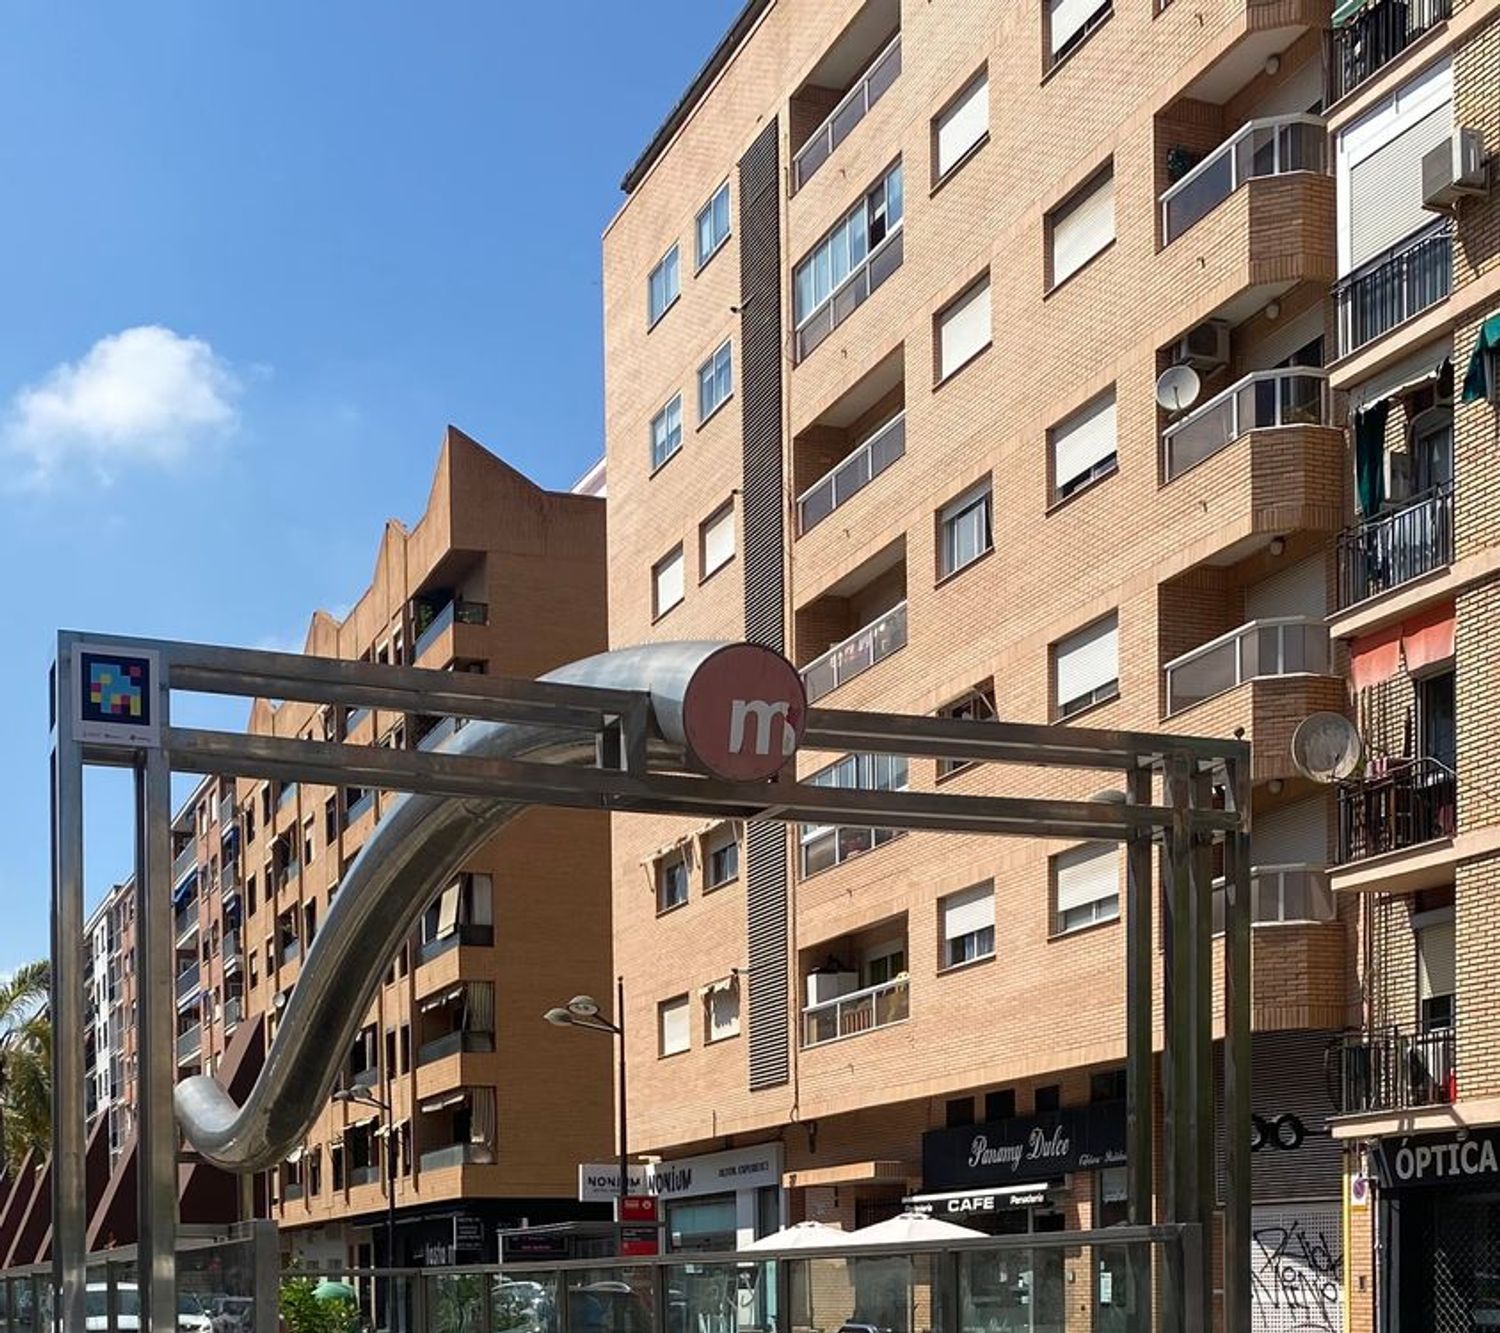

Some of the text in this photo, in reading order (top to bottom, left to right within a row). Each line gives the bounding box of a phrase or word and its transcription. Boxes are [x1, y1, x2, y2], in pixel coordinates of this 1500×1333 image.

[1025, 1125, 1070, 1160] Dulce
[1395, 1137, 1499, 1180] ÓPTICA
[947, 1196, 995, 1212] CAFE
